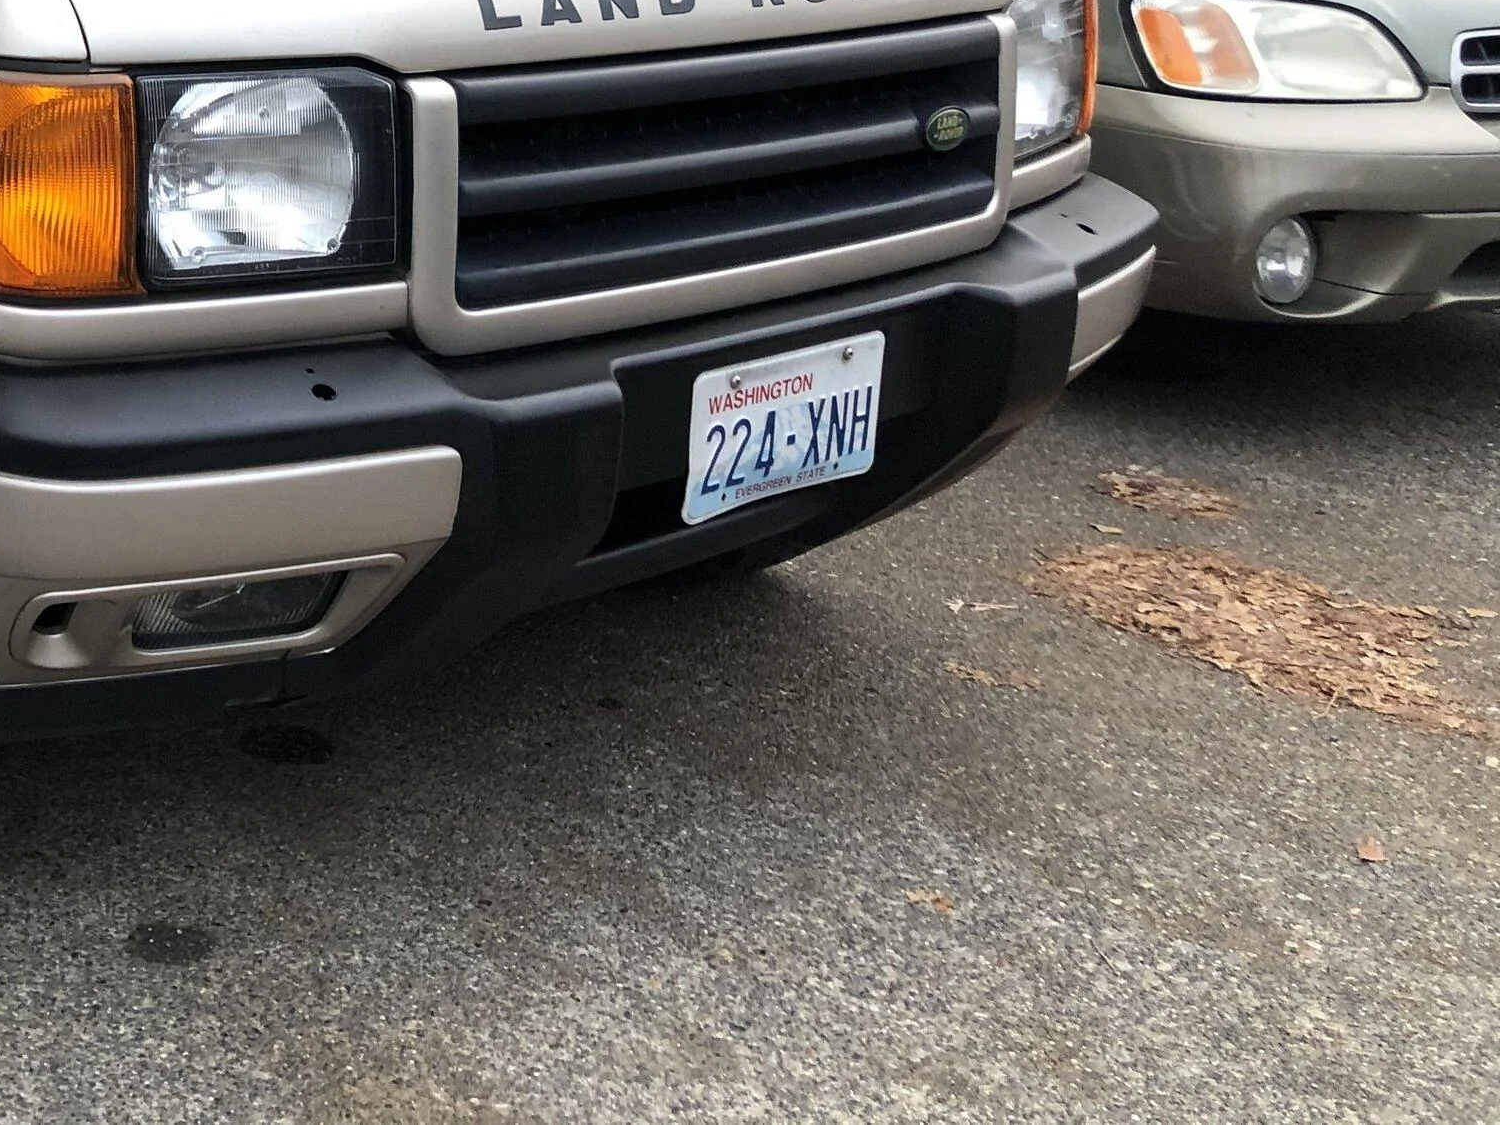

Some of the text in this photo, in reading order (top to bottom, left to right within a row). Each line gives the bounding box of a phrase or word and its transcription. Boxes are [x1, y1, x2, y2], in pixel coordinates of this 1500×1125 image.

[708, 373, 814, 415] WASHINGTON
[700, 386, 873, 496] 224-XNH
[734, 466, 827, 500] EVERGREEN STATE
